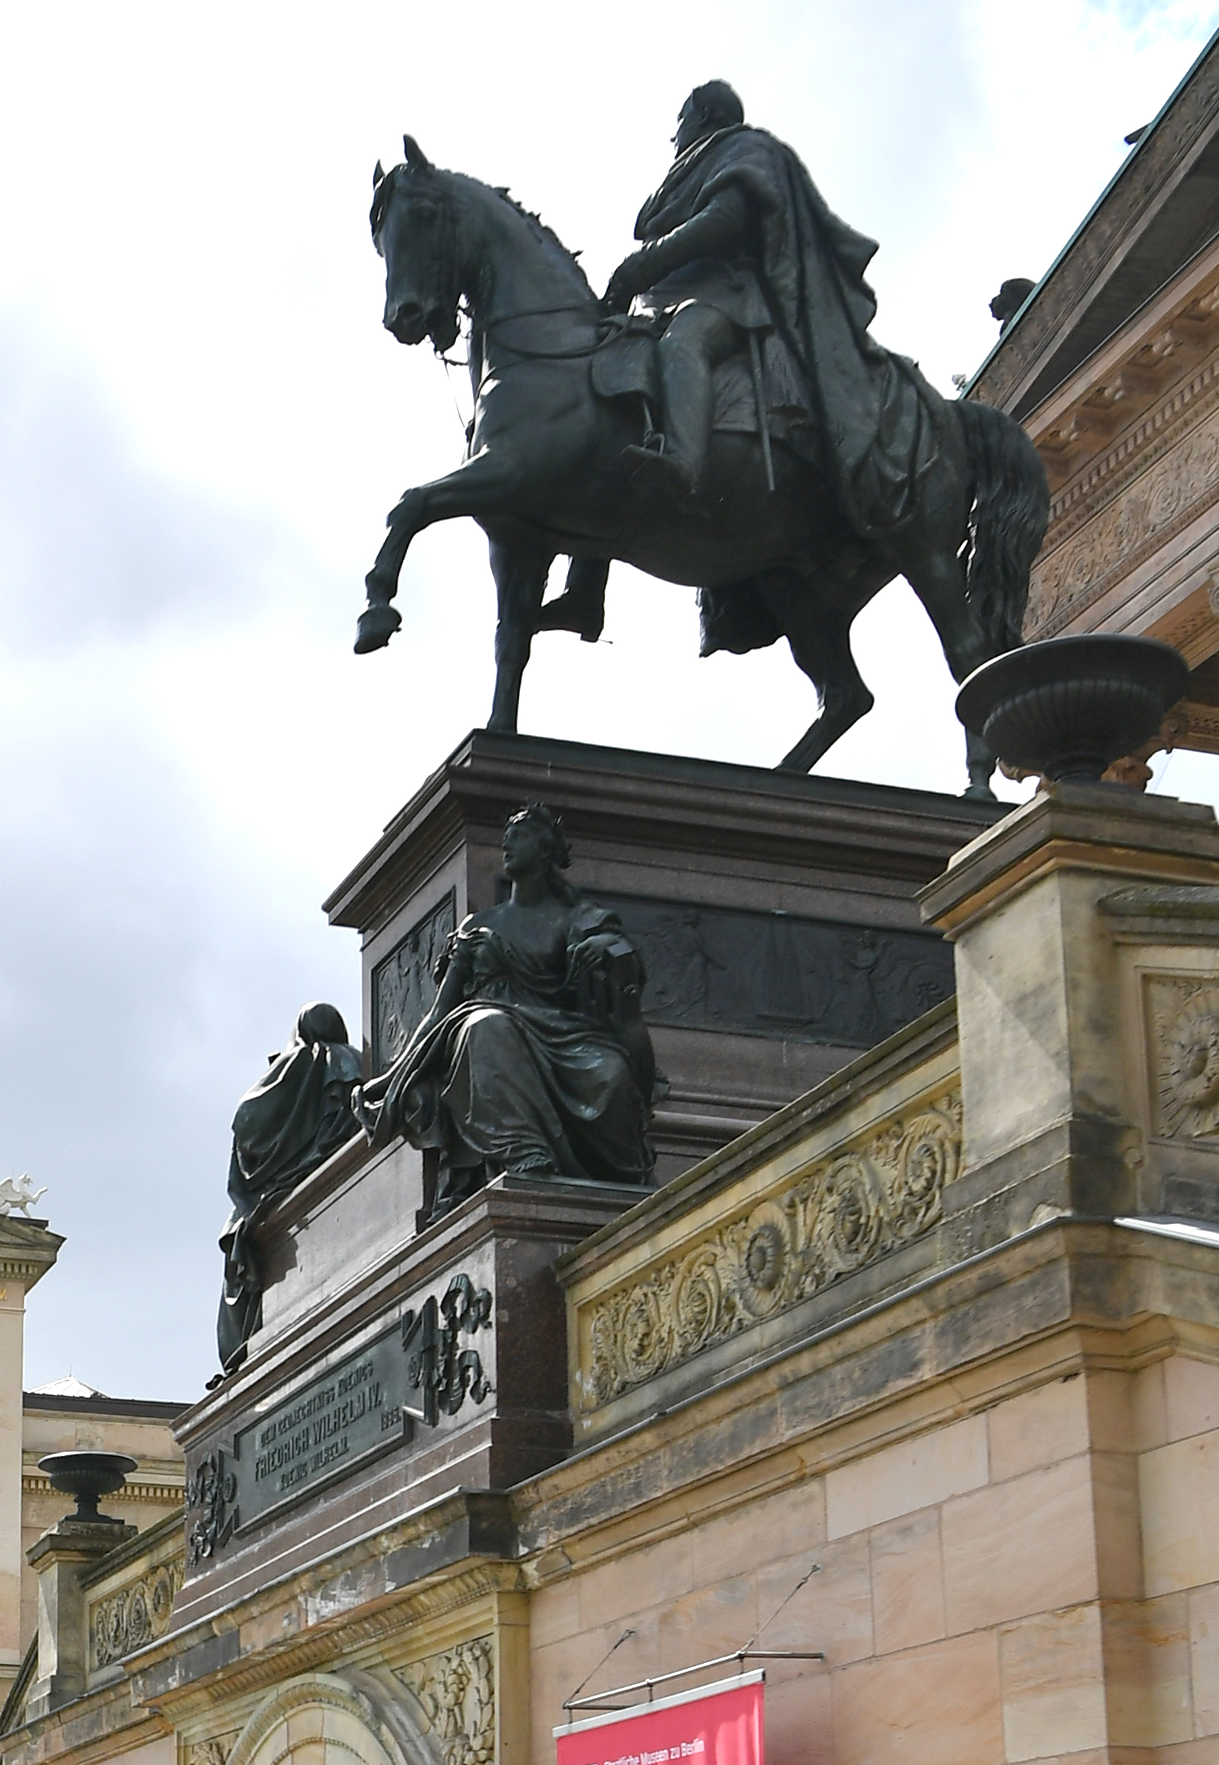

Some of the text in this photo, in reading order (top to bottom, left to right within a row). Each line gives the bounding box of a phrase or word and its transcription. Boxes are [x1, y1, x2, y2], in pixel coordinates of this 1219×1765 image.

[255, 1427, 310, 1482] FRIEDRICH
[313, 1391, 365, 1445] WILHELM
[640, 1749, 669, 1765] Museen
[670, 1746, 681, 1760] zu
[681, 1738, 705, 1757] Berlin
